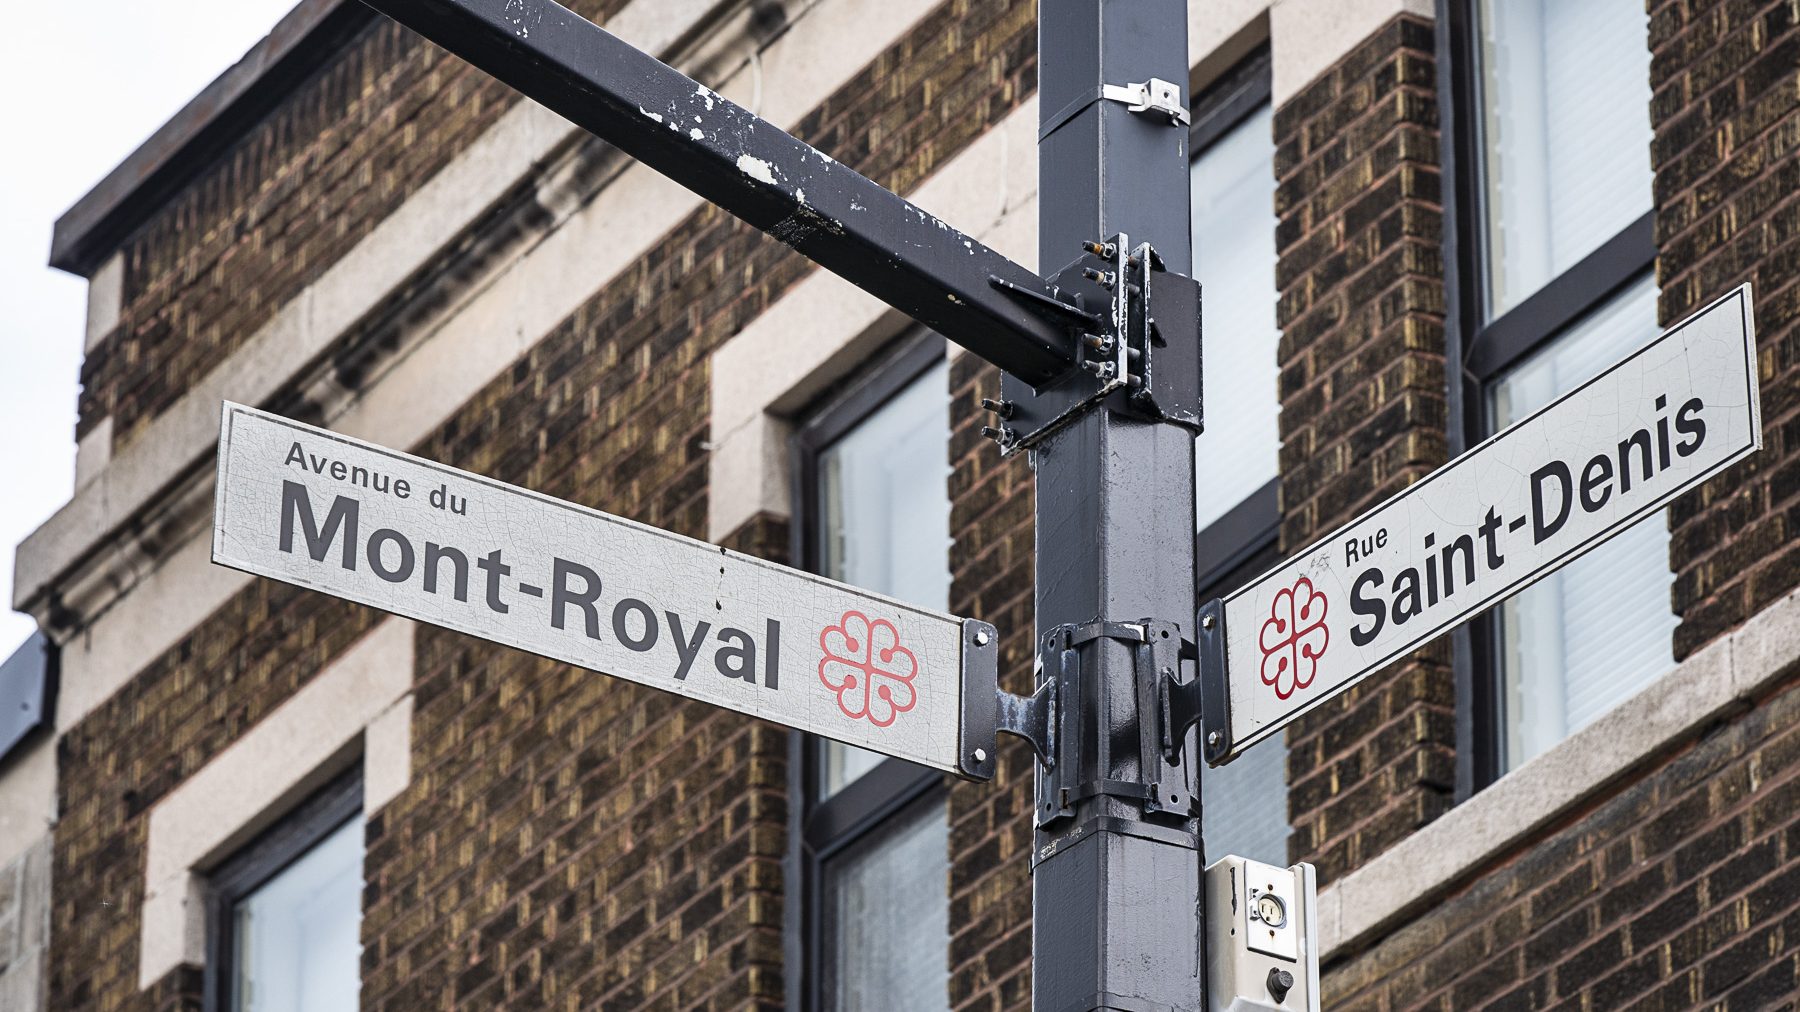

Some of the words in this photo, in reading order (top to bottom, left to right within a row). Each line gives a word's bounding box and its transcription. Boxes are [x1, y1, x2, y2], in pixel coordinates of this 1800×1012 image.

[284, 441, 411, 499] Avenue
[429, 484, 467, 516] du
[1344, 525, 1389, 568] Rue
[1349, 393, 1707, 647] Saint-Denis
[278, 480, 780, 691] Mont-Royal
